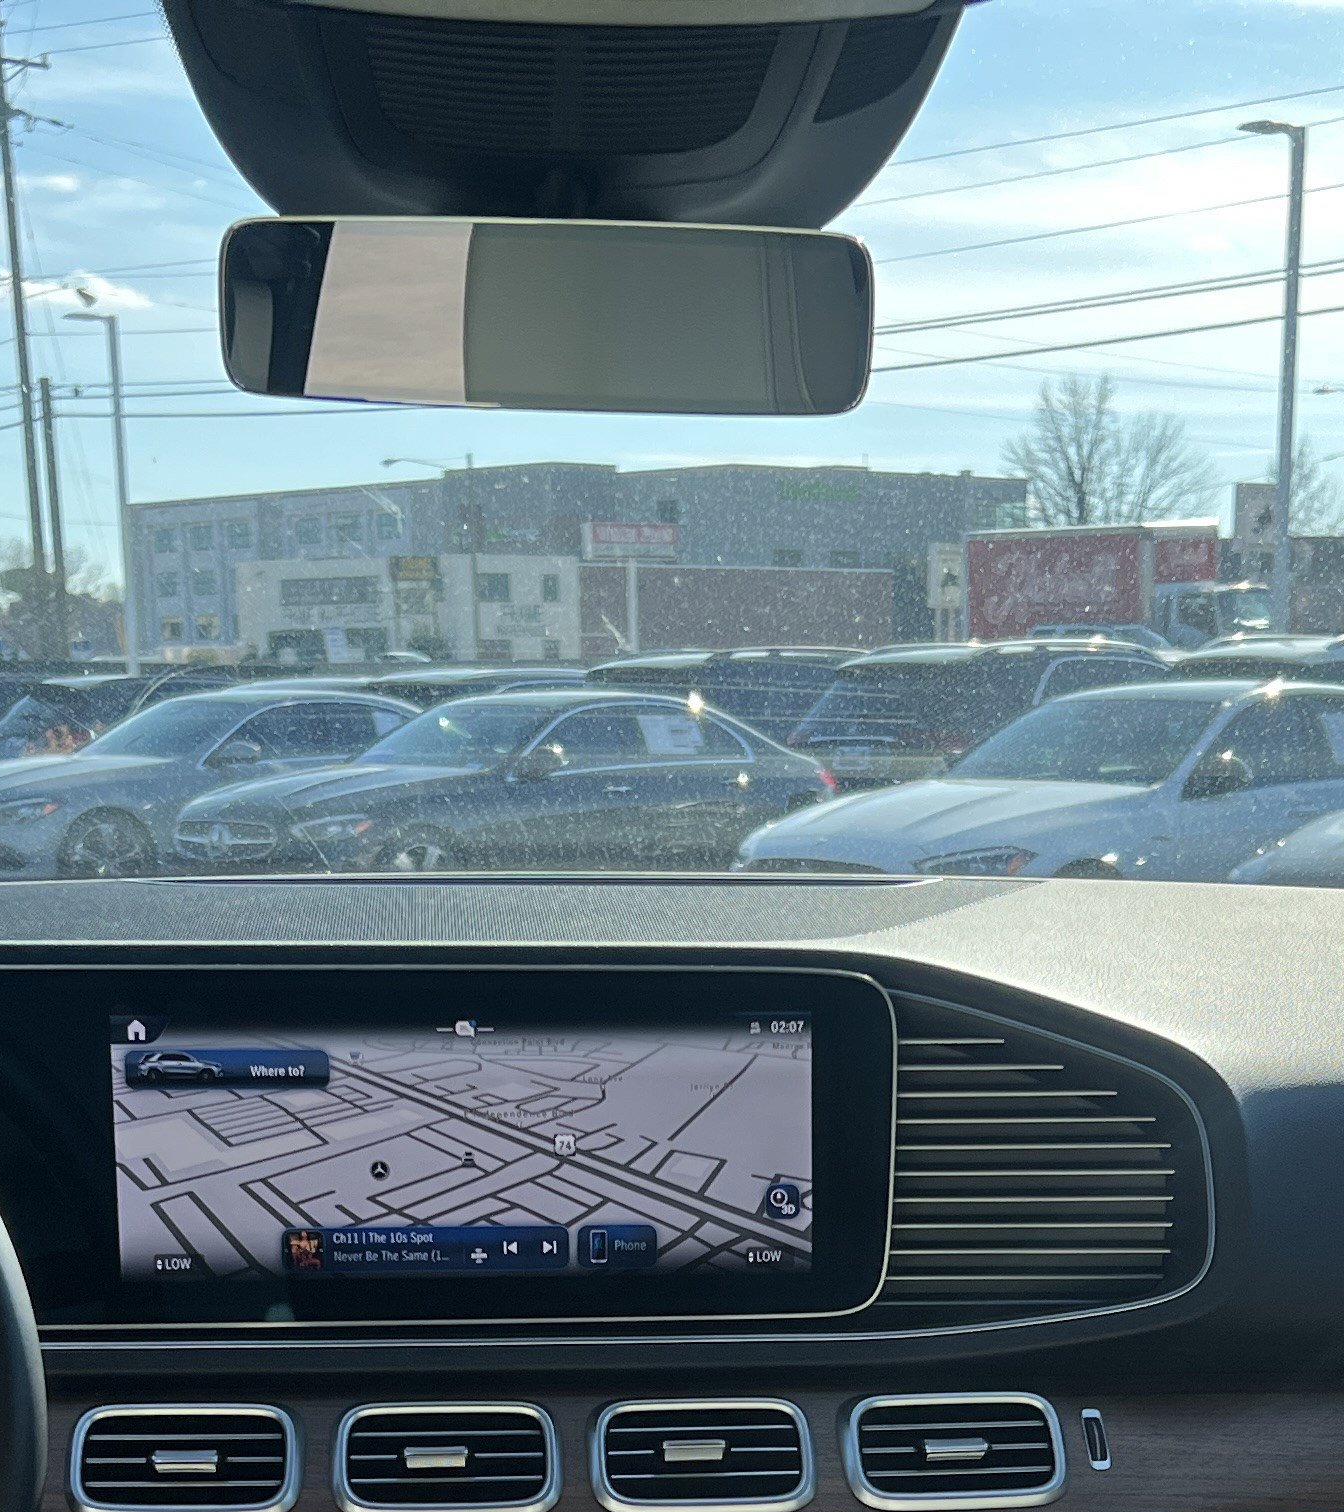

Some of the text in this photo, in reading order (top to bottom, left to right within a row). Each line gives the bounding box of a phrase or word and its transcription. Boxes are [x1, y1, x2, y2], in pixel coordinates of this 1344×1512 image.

[770, 1020, 805, 1034] 02:07
[249, 1063, 306, 1078] Where to?
[558, 1138, 574, 1153] 74
[781, 1204, 796, 1216] 3D
[332, 1231, 359, 1244] Ch11
[368, 1231, 387, 1244] The
[390, 1231, 408, 1244] 10s
[410, 1231, 434, 1246] Spot
[613, 1237, 647, 1254] Phone
[333, 1251, 363, 1262] Never
[365, 1250, 379, 1262] Be
[381, 1250, 400, 1262] The
[402, 1249, 429, 1262] Same
[756, 1250, 783, 1264] LOW
[164, 1257, 192, 1271] LOW
